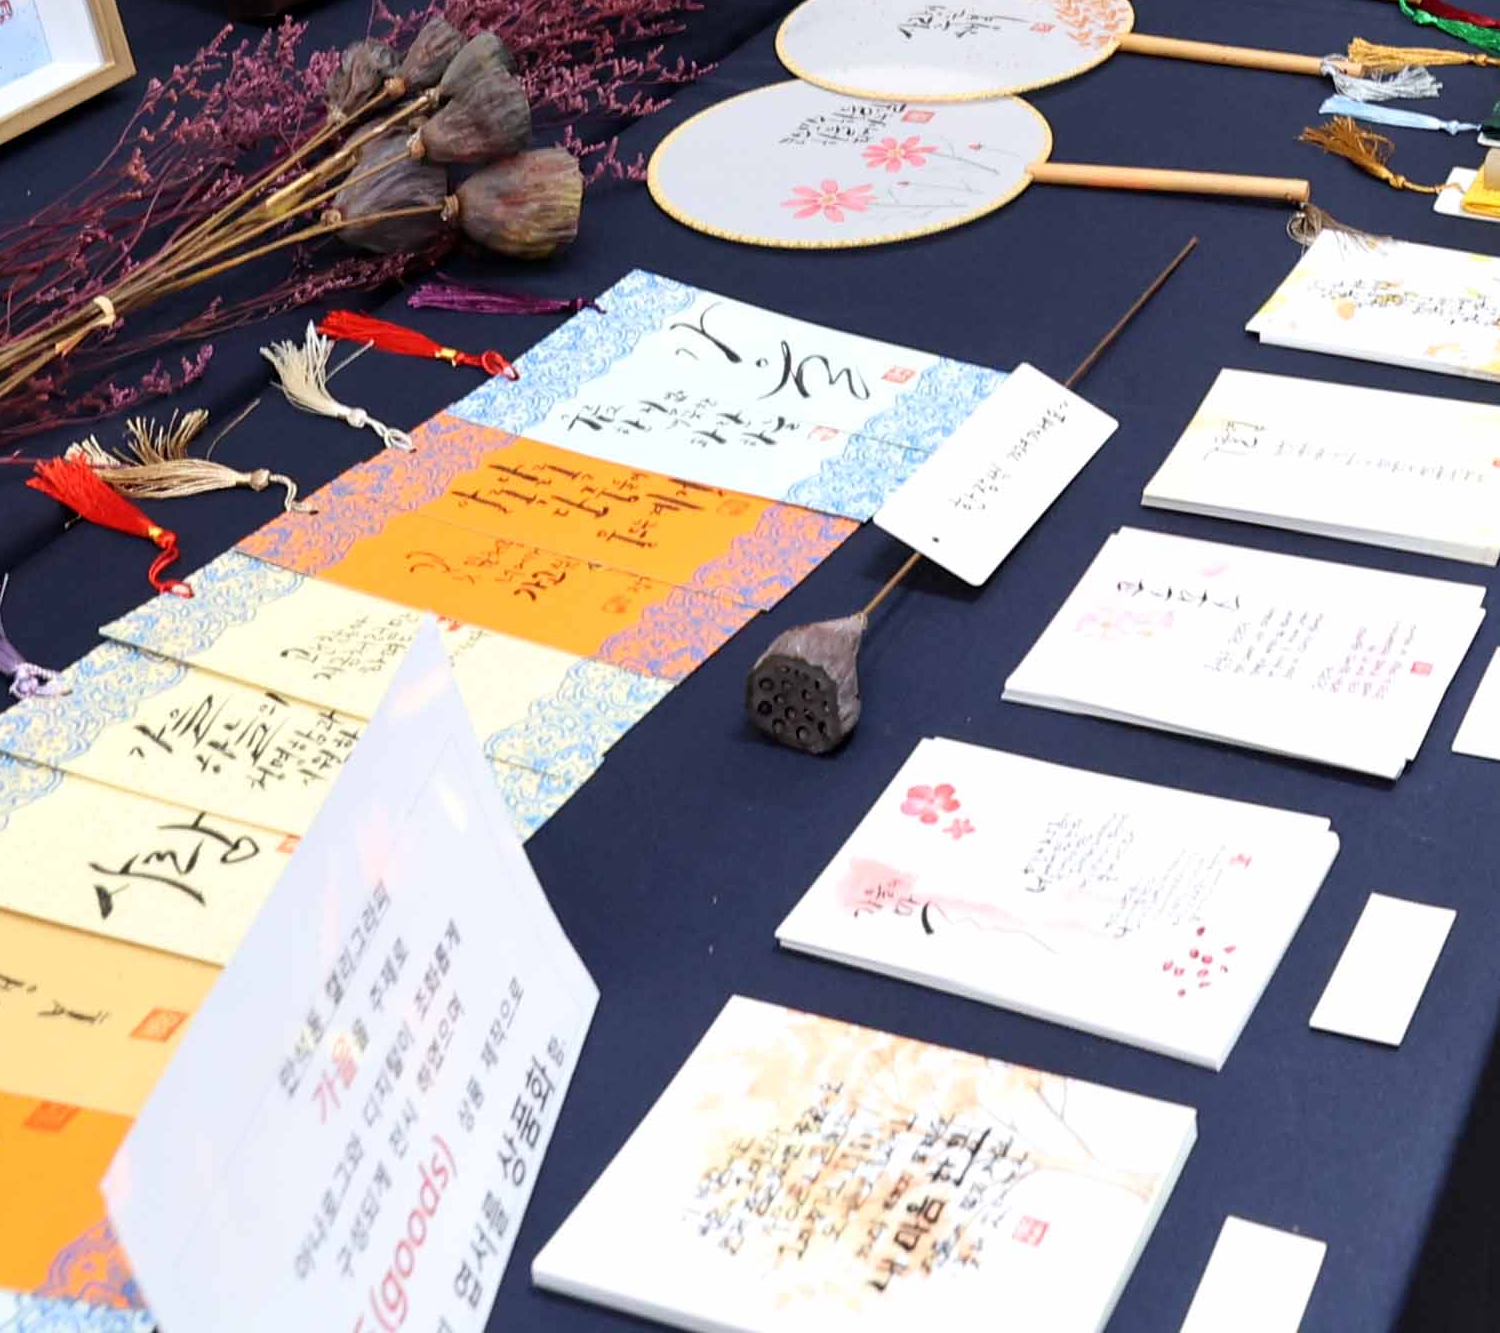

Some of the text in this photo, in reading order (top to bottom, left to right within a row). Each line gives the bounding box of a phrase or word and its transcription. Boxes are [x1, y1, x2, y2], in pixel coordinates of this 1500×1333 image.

[90, 813, 260, 919] 사랑
[499, 1053, 563, 1188] 상품화
[893, 1195, 946, 1253] 마음
